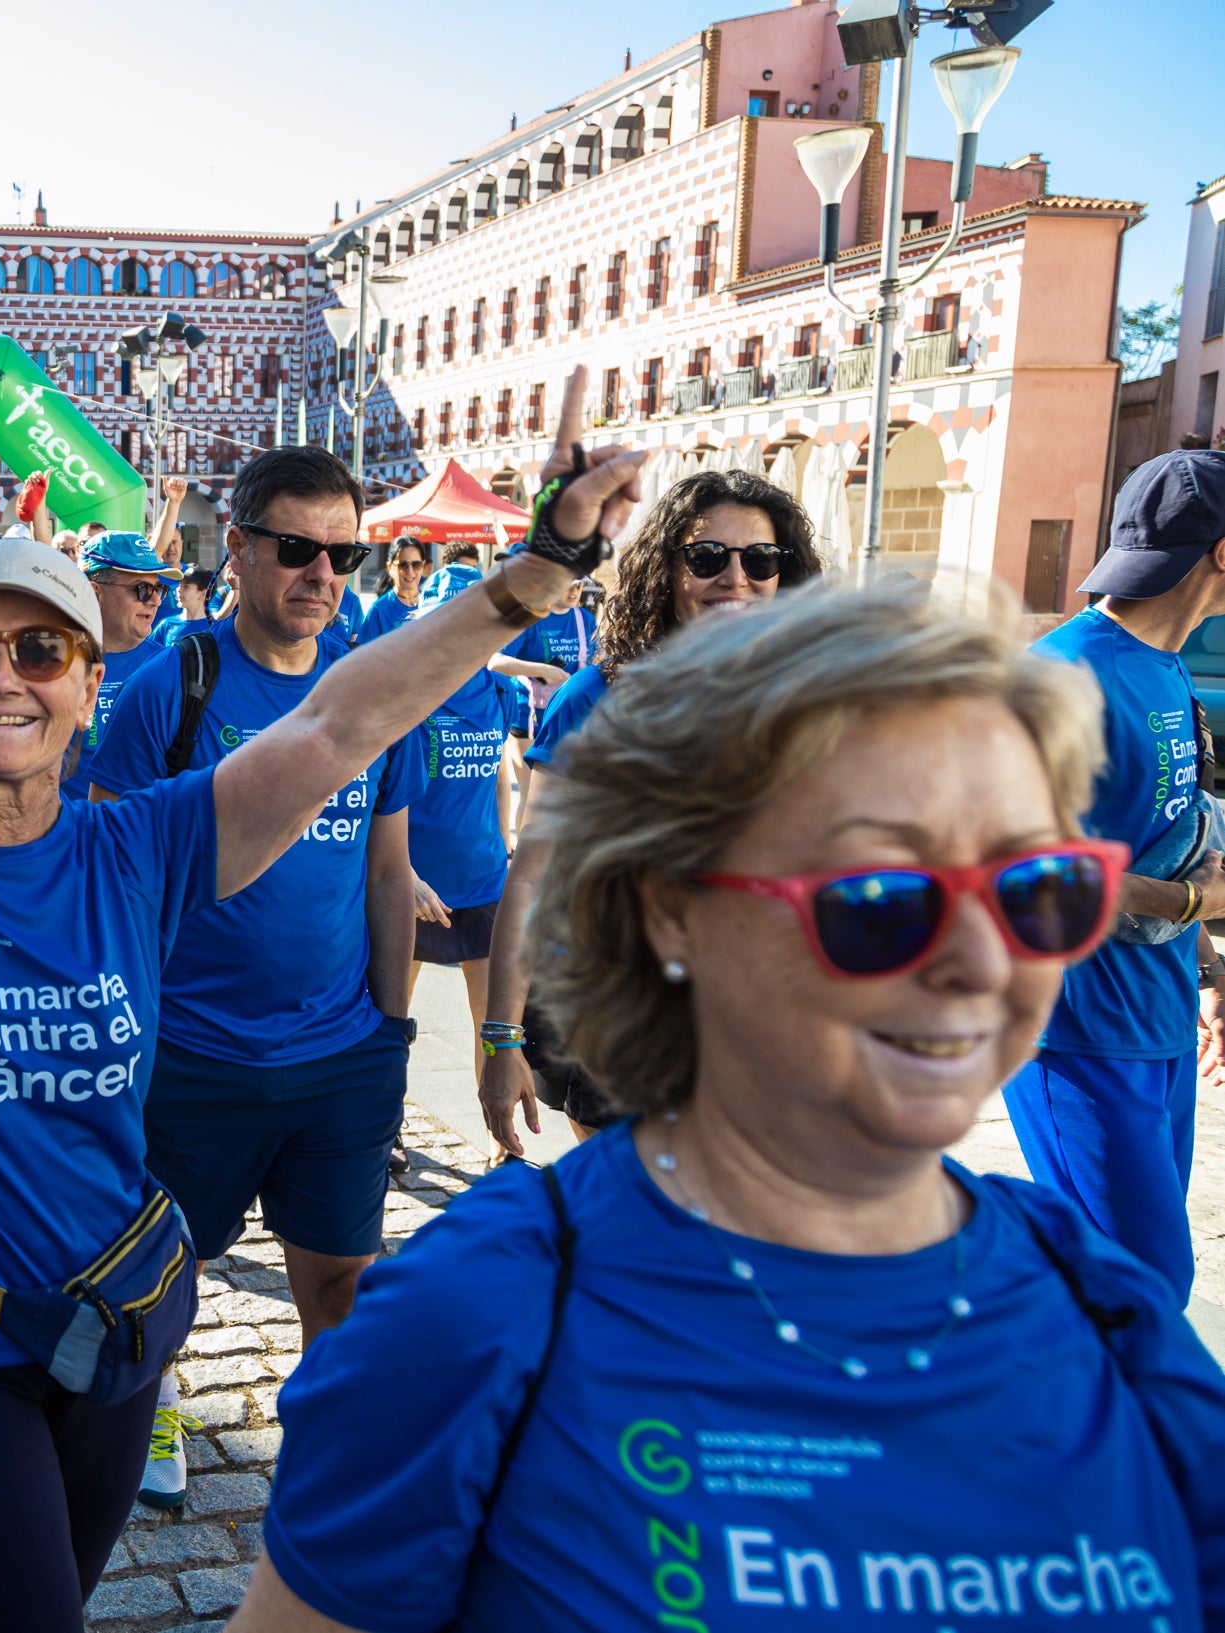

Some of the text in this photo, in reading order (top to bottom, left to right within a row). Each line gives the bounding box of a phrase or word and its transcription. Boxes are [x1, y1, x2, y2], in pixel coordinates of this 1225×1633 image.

[28, 419, 105, 495] aecc
[441, 729, 460, 742] En
[443, 743, 494, 758] contra
[1170, 738, 1187, 760] En
[429, 729, 439, 778] BADAJOZ
[346, 784, 367, 808] el
[109, 1001, 142, 1044] el
[723, 1523, 1175, 1616] En marcha
